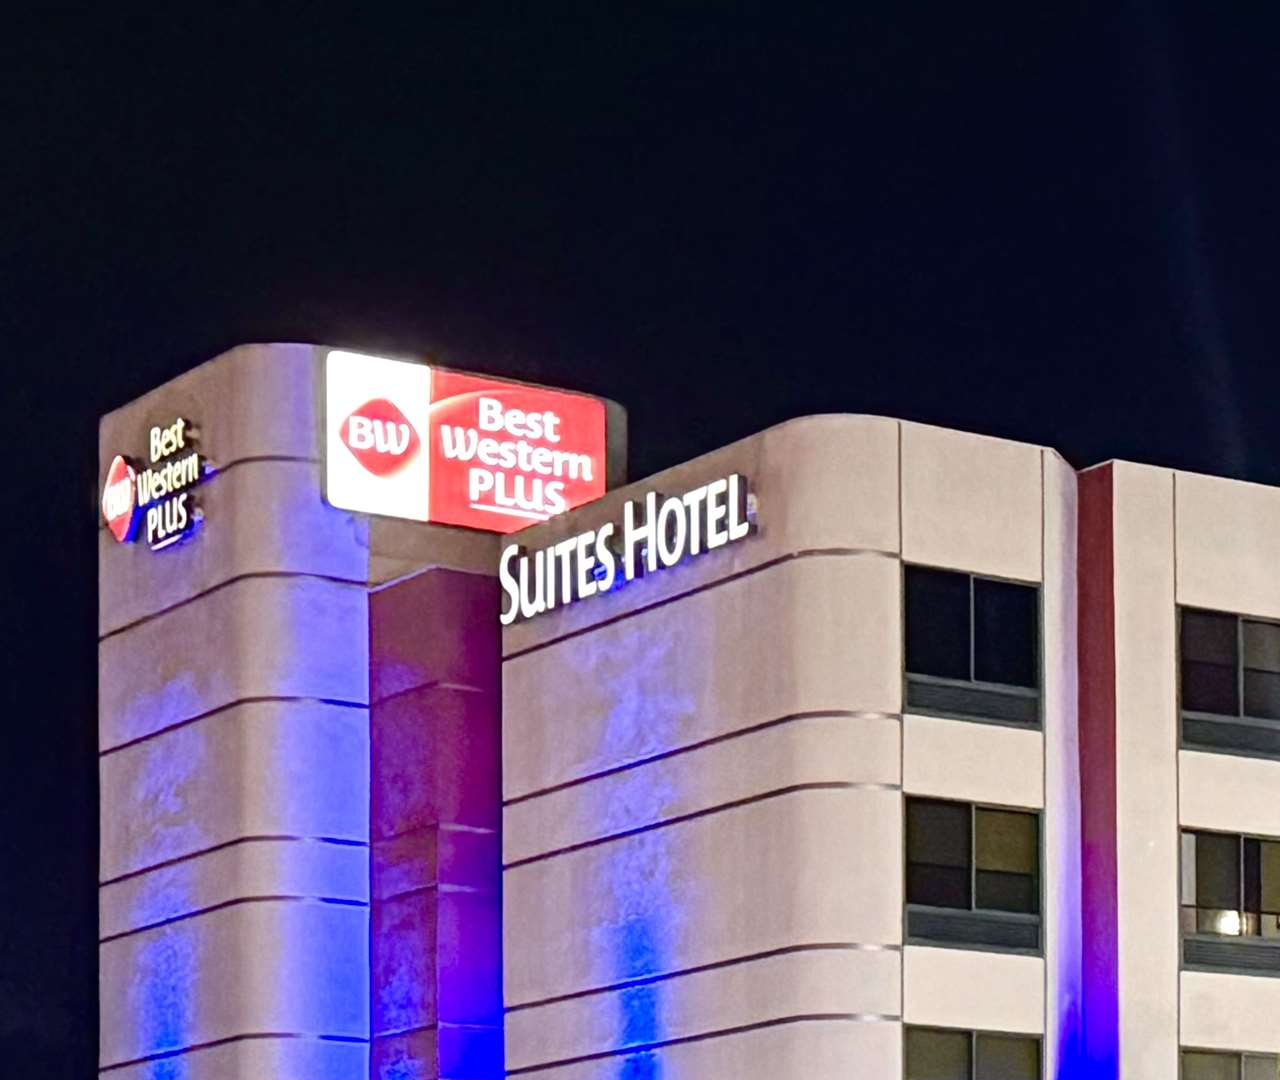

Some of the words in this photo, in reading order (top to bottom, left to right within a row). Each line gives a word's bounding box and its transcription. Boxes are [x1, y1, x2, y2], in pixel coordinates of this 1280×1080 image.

[150, 417, 185, 462] Best
[349, 415, 410, 455] BW
[479, 397, 560, 442] Best
[440, 424, 593, 480] Western
[137, 453, 199, 507] Western
[469, 468, 566, 514] PLUS
[147, 493, 187, 543] PLUS
[500, 522, 615, 625] SUITES
[624, 473, 749, 580] HOTEL
